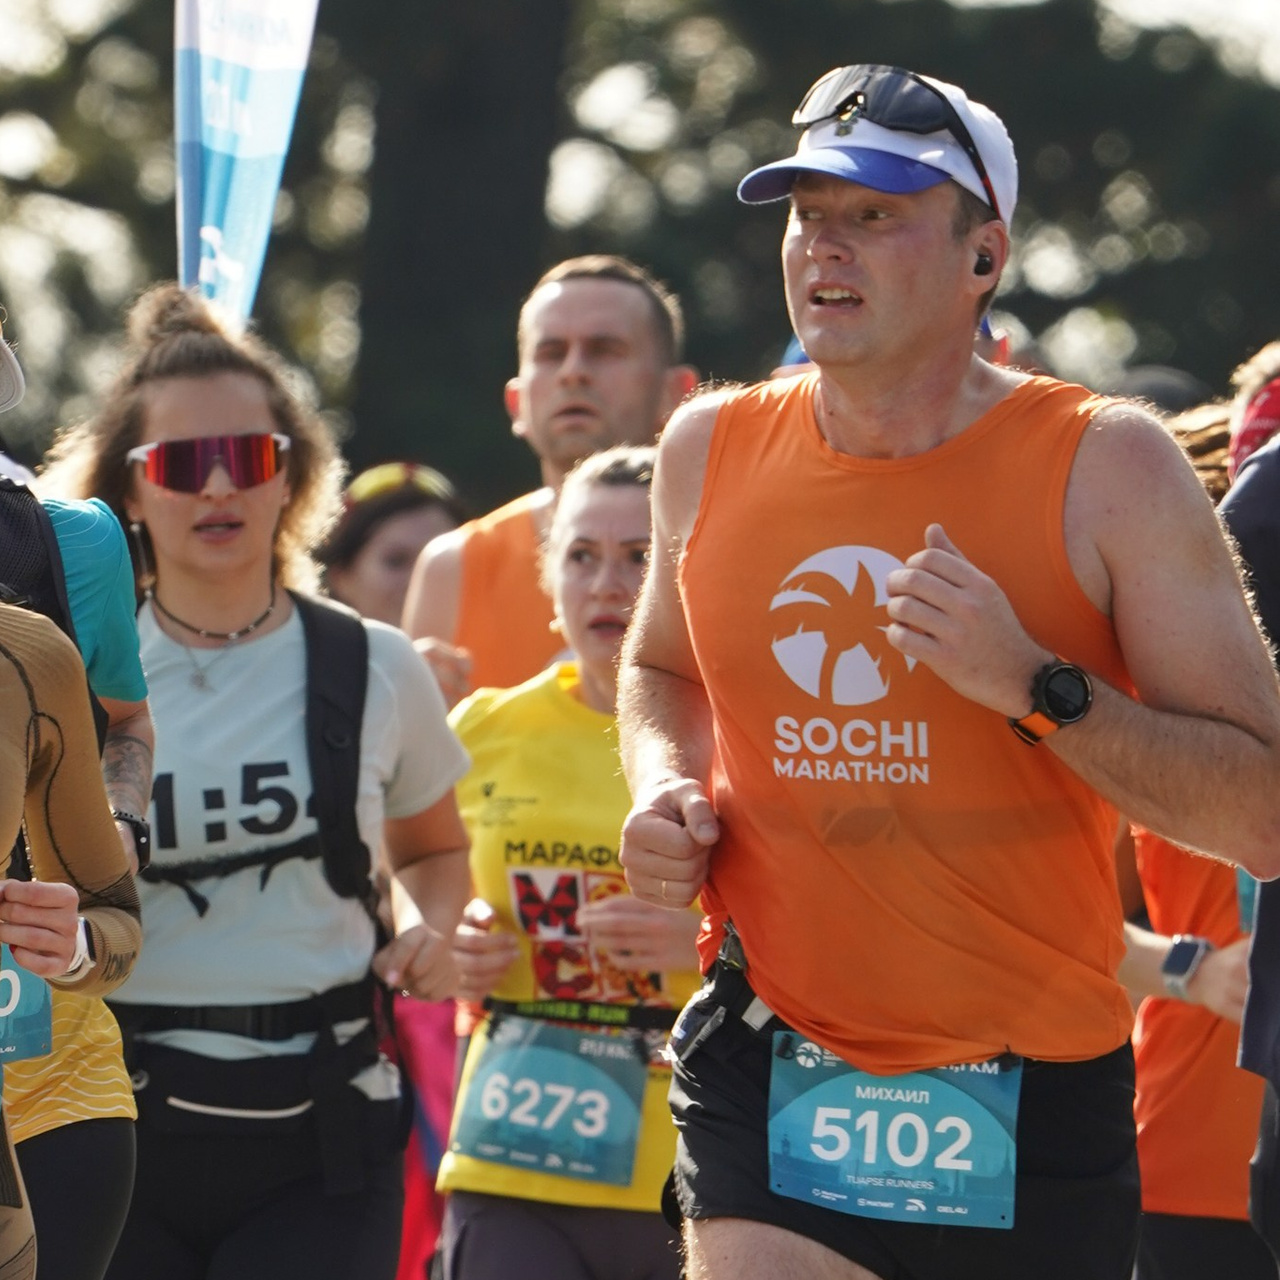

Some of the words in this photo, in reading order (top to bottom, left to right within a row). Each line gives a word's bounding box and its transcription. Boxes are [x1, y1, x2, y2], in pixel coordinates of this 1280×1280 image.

[774, 715, 929, 758] SOCHI
[773, 757, 930, 785] MARATHON
[151, 761, 315, 849] 1:5
[480, 1071, 610, 1138] 6273
[855, 1085, 930, 1104] МИХАИЛ
[810, 1106, 973, 1171] 5102
[846, 1175, 885, 1187] TUAPSE
[886, 1179, 935, 1190] RUNNERS
